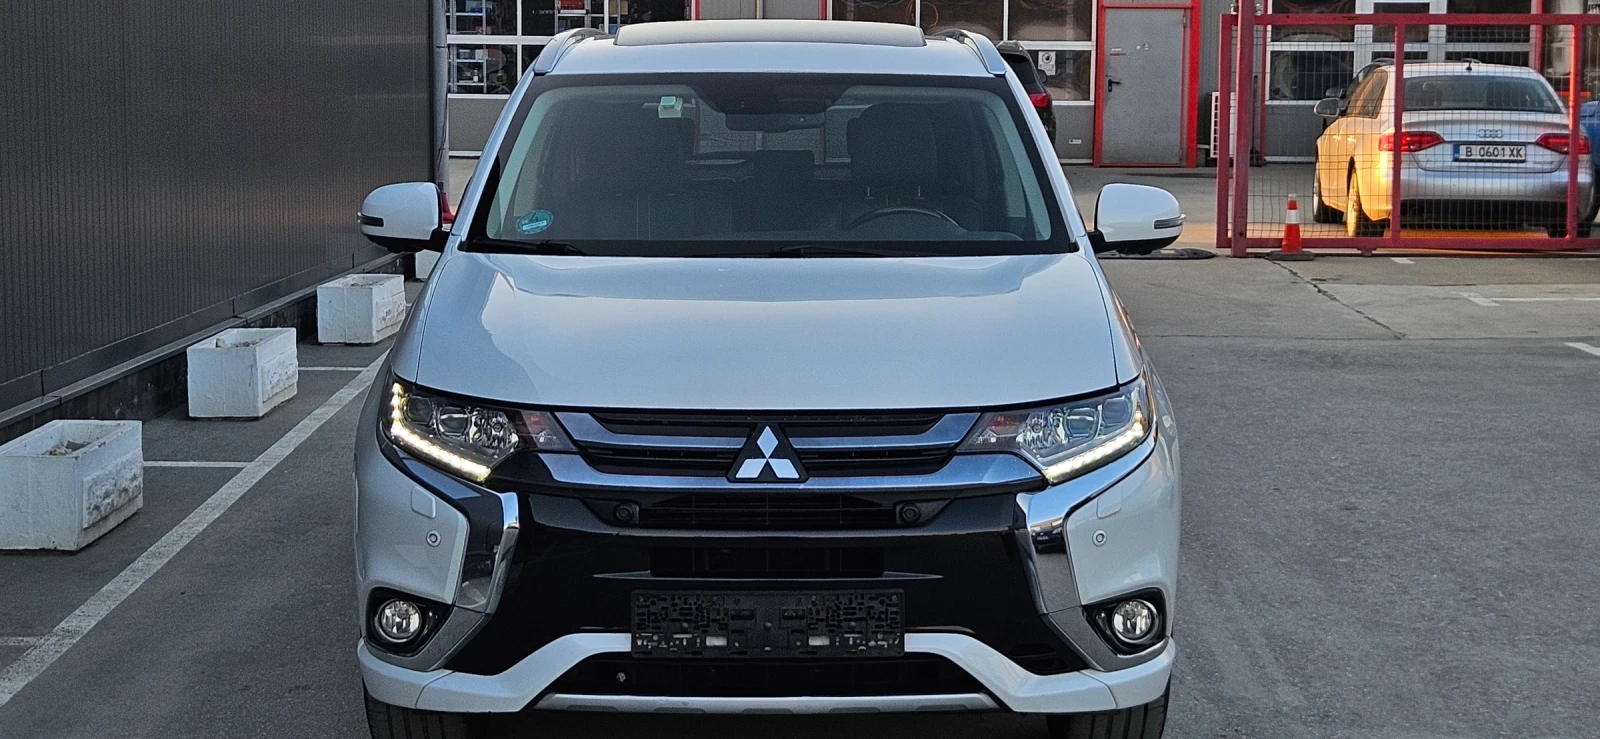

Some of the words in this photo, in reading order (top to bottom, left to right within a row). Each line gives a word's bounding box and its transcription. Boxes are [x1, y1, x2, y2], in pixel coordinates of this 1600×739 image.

[1465, 146, 1473, 157] B
[1478, 147, 1506, 158] 0601
[1509, 147, 1523, 158] XK
